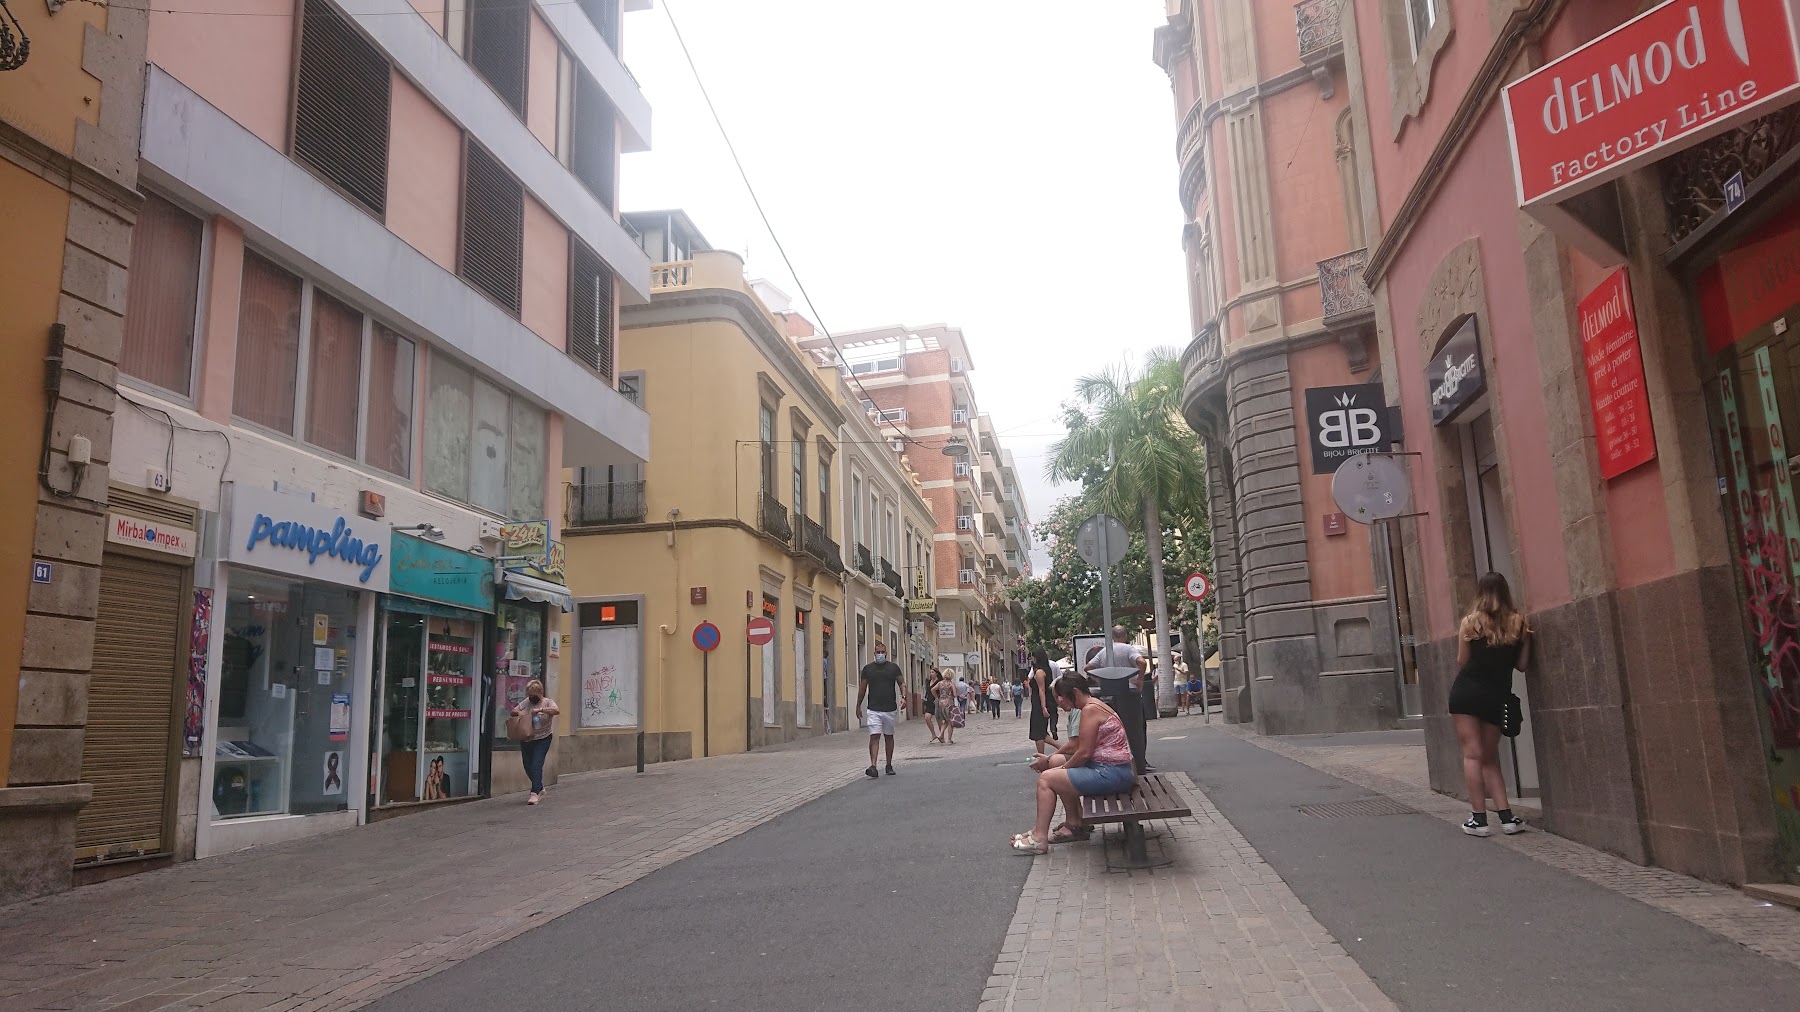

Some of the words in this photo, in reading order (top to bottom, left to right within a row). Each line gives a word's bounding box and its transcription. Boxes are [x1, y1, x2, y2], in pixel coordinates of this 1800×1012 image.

[1550, 118, 1667, 185] Factory
[1678, 80, 1758, 129] Line
[1726, 181, 1741, 202] 74
[1588, 349, 1605, 368] Mode
[1605, 328, 1635, 357] féminine
[1593, 364, 1606, 386] prêt
[1612, 347, 1632, 372] porter
[1611, 375, 1619, 387] et
[1596, 391, 1613, 412] haute
[1613, 376, 1639, 402] couture
[1323, 449, 1345, 459] BIJOU
[154, 473, 163, 488] 63
[117, 518, 147, 541] Mirbal
[154, 527, 181, 549] Impex
[246, 513, 383, 583] pampling
[36, 566, 48, 578] 61
